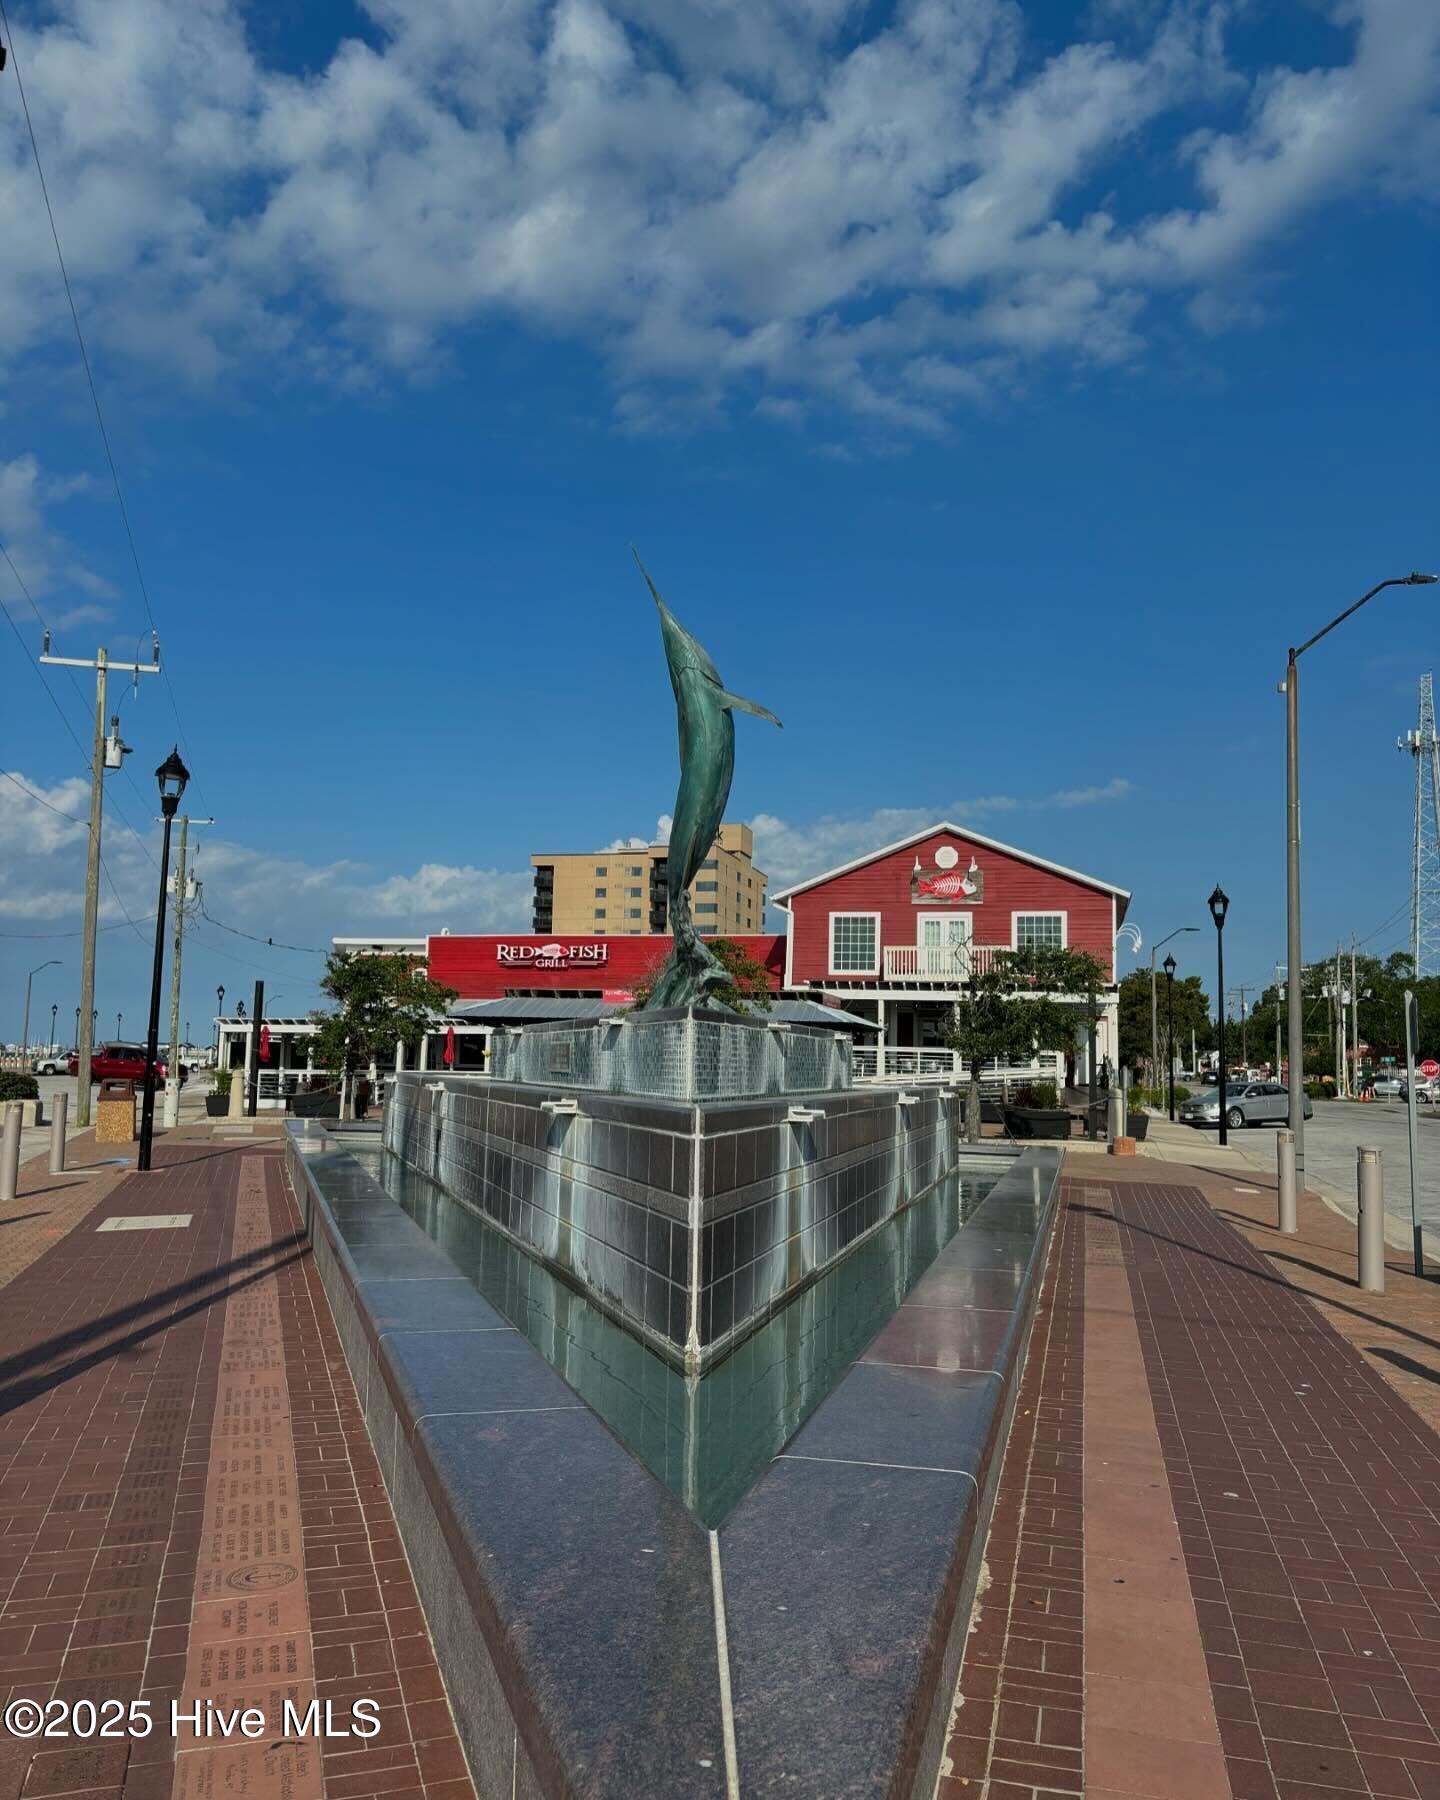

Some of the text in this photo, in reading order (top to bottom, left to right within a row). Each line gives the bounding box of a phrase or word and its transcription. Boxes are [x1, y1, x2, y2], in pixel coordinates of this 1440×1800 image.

[496, 943, 607, 960] RED FISH
[535, 958, 568, 968] GRILL
[1421, 1064, 1438, 1073] STOP
